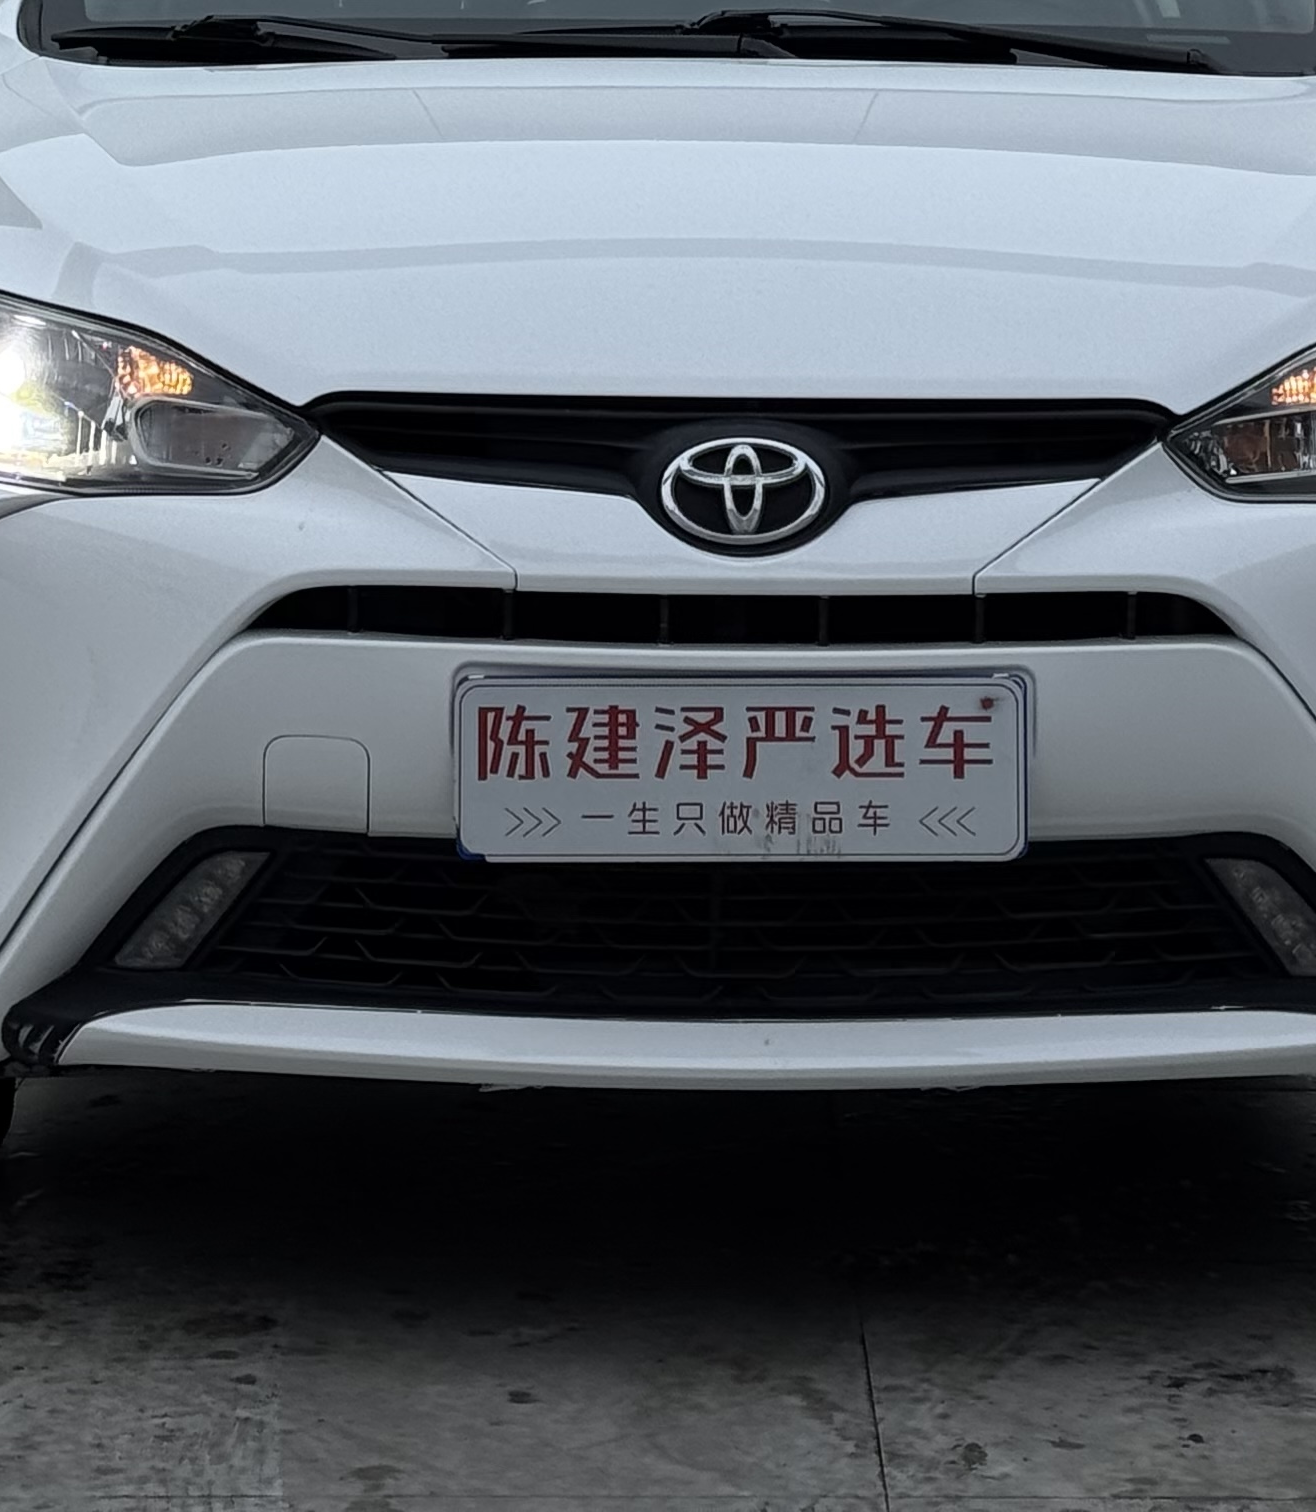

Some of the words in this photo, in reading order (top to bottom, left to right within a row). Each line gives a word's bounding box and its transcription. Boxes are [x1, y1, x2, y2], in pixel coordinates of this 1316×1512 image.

[477, 704, 994, 781] 陈建泽严选车
[581, 800, 891, 836] 一生只做精品车
